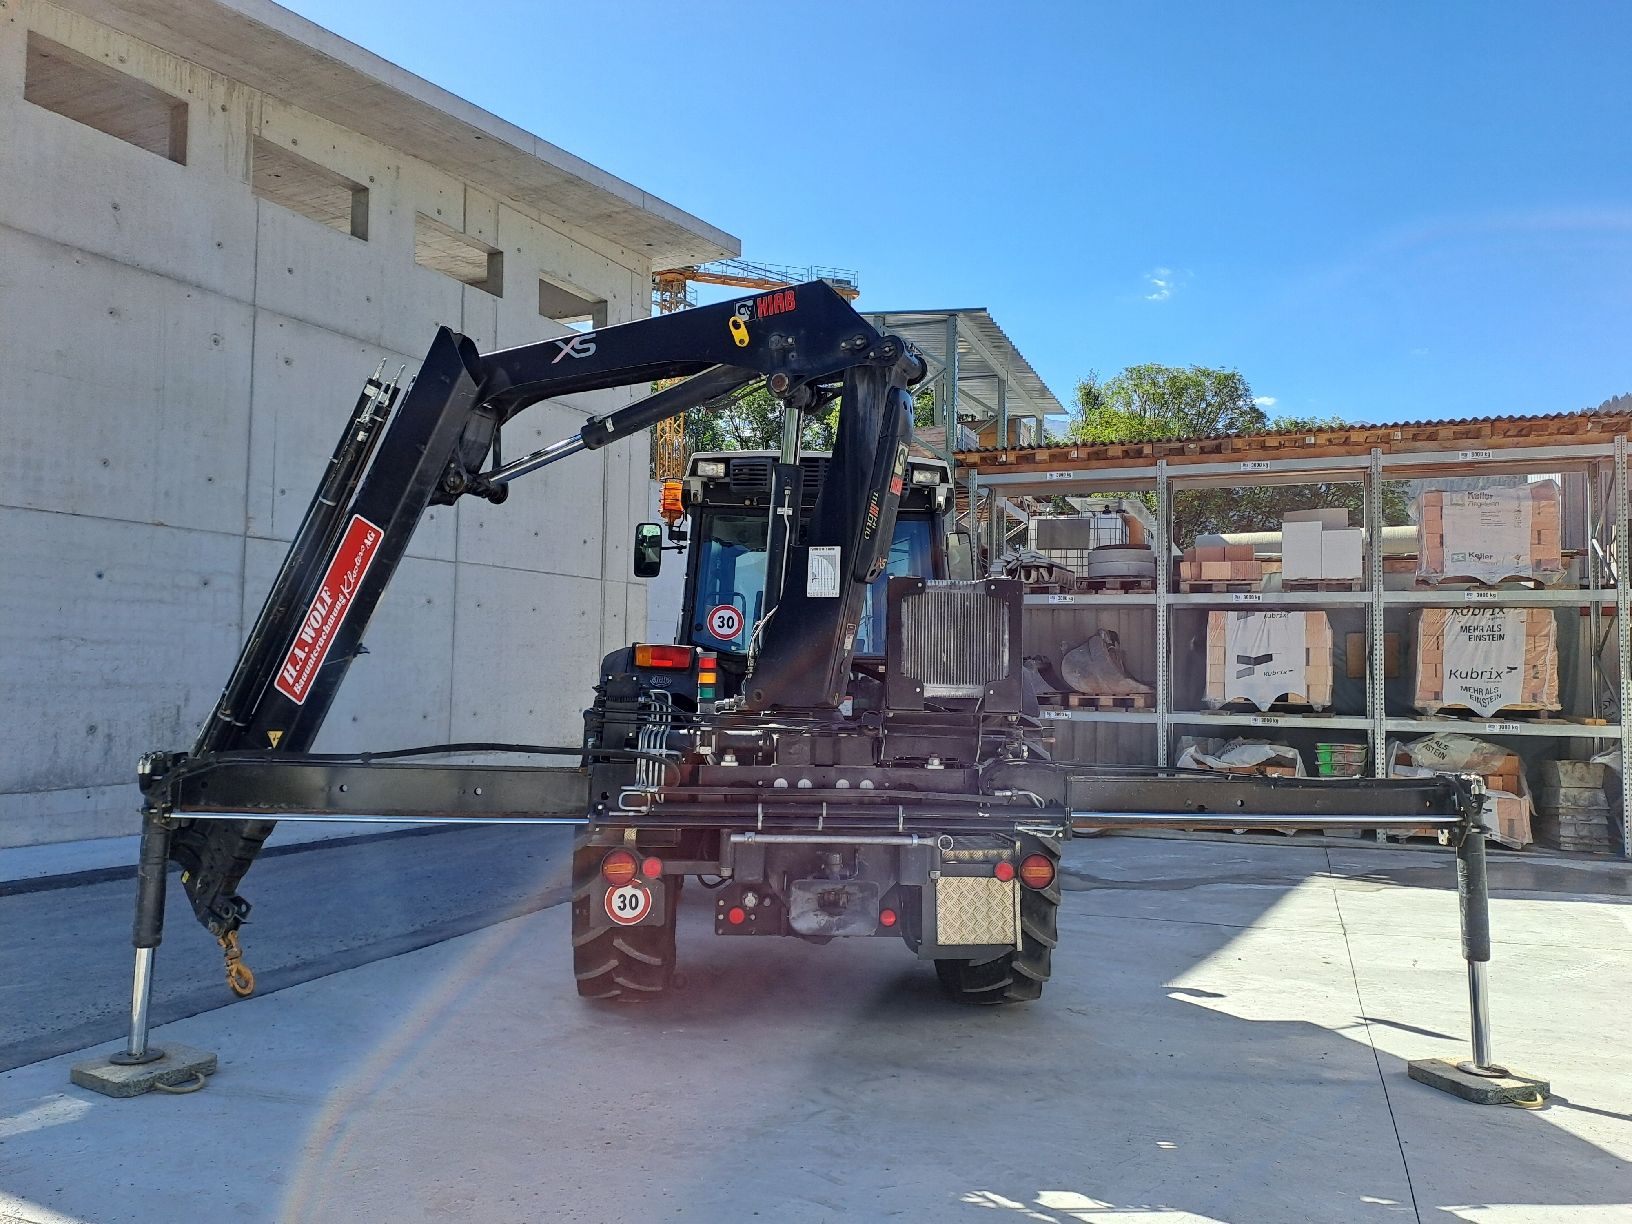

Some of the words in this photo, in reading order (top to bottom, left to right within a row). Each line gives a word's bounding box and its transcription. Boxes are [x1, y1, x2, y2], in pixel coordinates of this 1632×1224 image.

[757, 289, 796, 318] HIAB
[551, 332, 597, 364] XS
[293, 593, 346, 695] Bauunternehmung
[364, 529, 376, 550] AG
[717, 615, 735, 629] 30
[1460, 625, 1484, 634] MEHR
[1486, 624, 1502, 633] ALS
[282, 646, 309, 686] H.A.
[300, 586, 334, 642] WOLF
[1468, 633, 1505, 642] EINSTEIN
[1448, 666, 1504, 680] Kubrix
[1460, 685, 1484, 696] MEHR
[1484, 686, 1499, 695] ALS
[1469, 693, 1502, 708] EINSTEIN
[617, 892, 639, 911] 30
